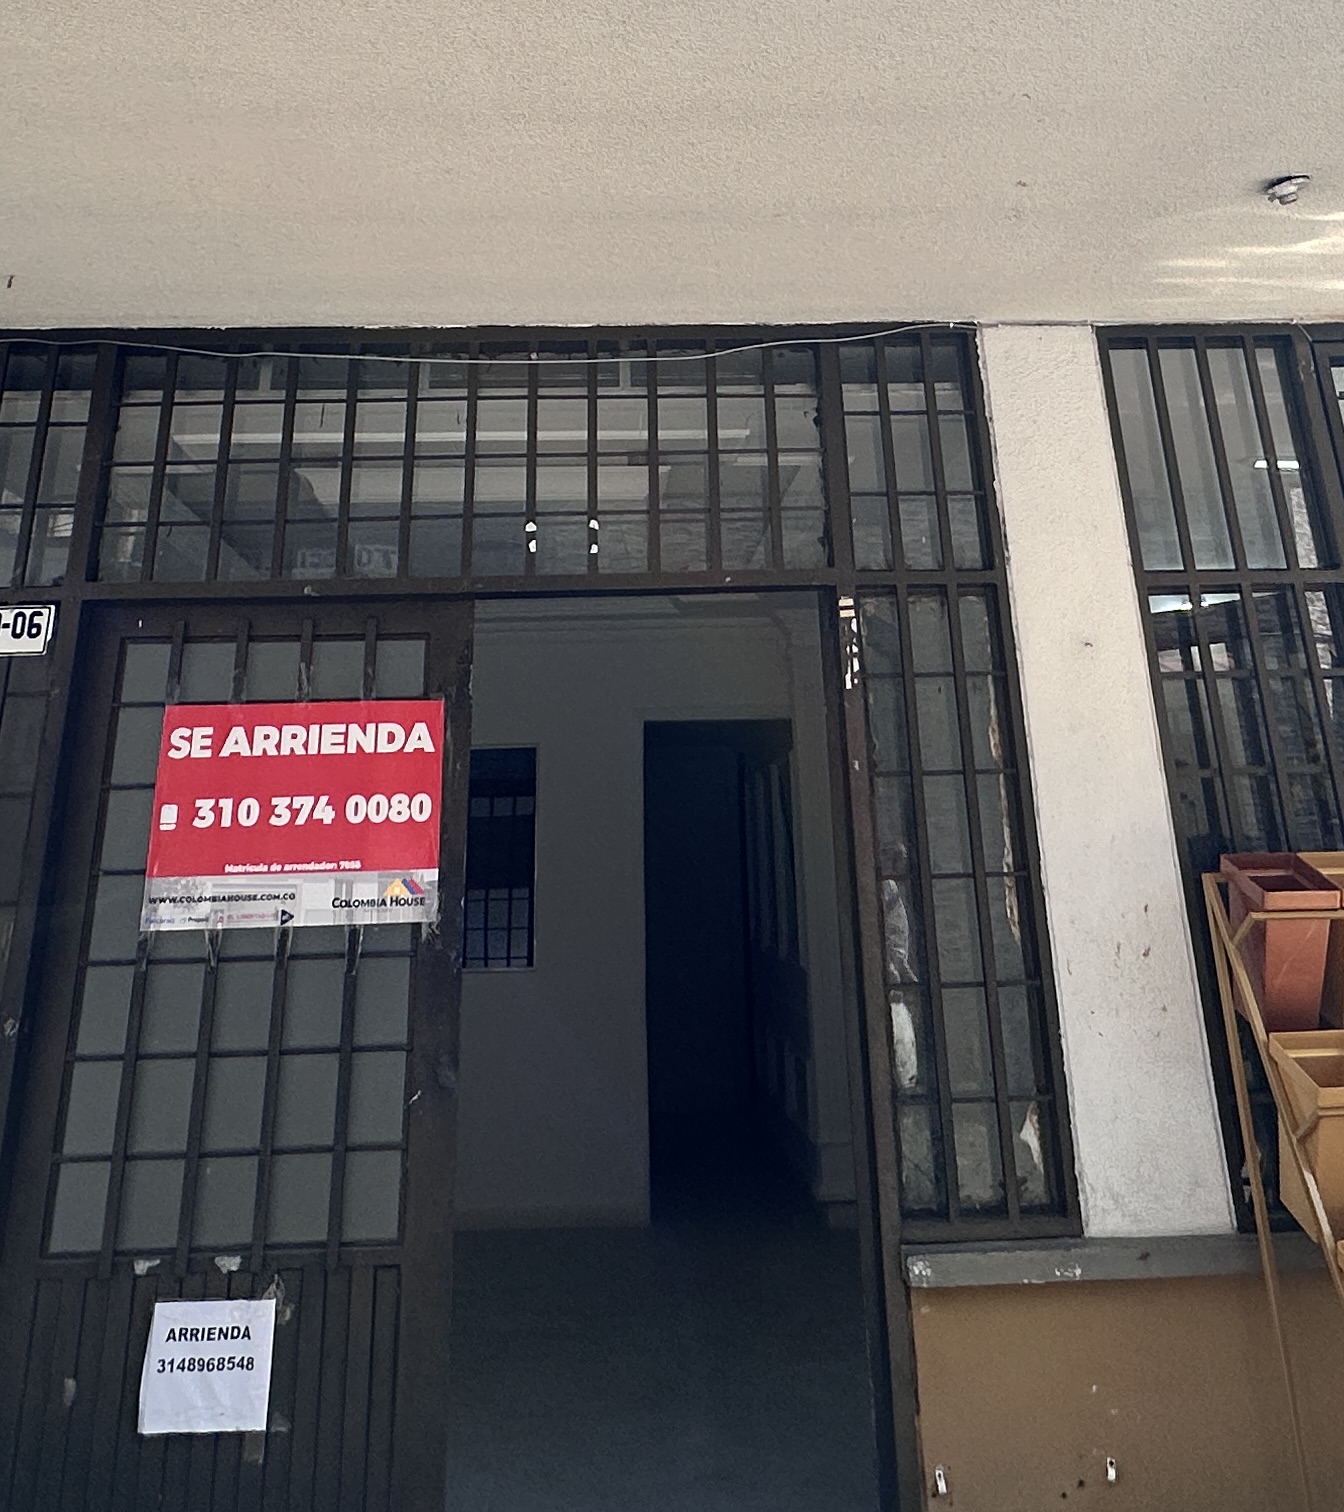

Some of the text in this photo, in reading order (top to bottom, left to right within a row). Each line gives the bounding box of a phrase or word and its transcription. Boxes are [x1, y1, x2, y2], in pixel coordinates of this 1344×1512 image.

[168, 722, 435, 759] SE ARRIENDA
[192, 792, 432, 828] 310 374 0080
[165, 1325, 252, 1342] ARRIENDA
[157, 1356, 254, 1374] 3148968548
